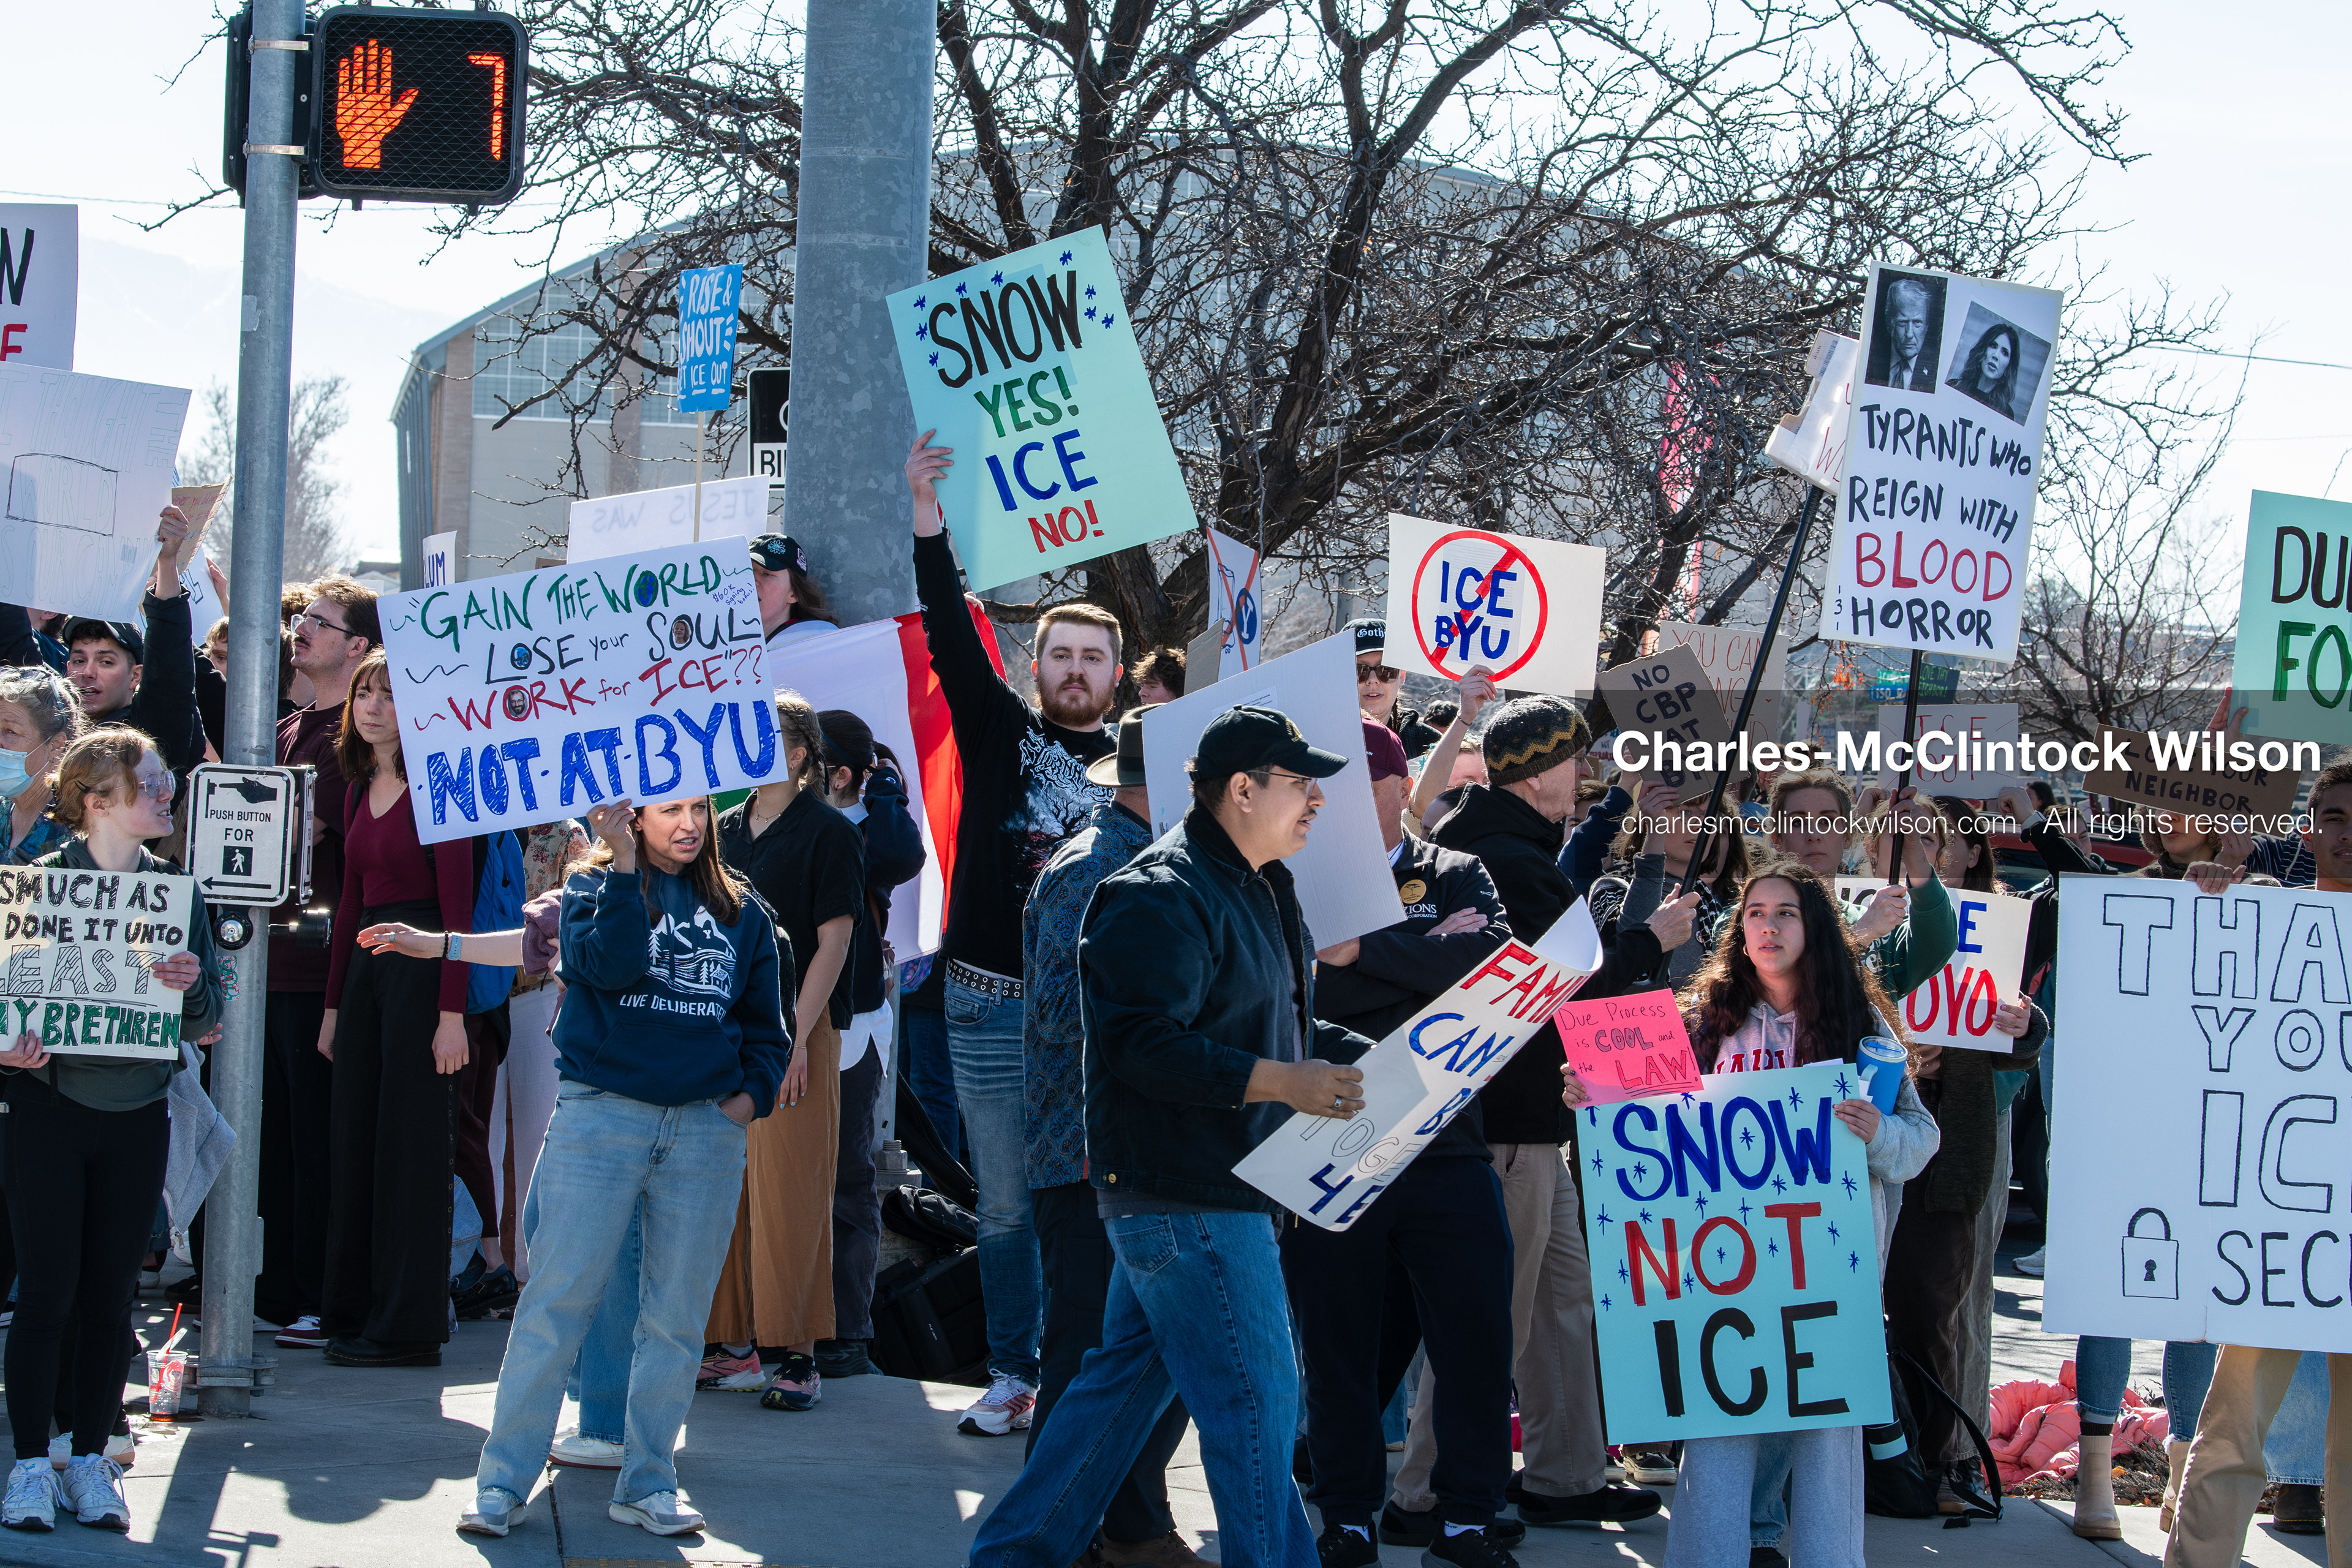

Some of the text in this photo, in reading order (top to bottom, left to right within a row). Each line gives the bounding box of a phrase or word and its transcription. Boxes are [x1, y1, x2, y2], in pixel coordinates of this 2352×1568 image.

[468, 51, 505, 160] 7
[687, 271, 733, 318] RISE &
[680, 317, 725, 365] SHOUT
[929, 270, 1082, 388] SNOW
[691, 363, 706, 388] ICE
[711, 361, 728, 386] OUT
[974, 366, 1079, 437] YES!
[29, 373, 162, 473] THOUGHT
[1860, 404, 2031, 476] TYRANTS WHO
[20, 454, 116, 536] WORLD
[986, 429, 1098, 512] ICE
[1028, 499, 1104, 554] NO!
[1849, 475, 2018, 544] REIGN WITH
[25, 527, 67, 605] OUR
[547, 573, 598, 622] THE
[593, 555, 723, 614] WORLD
[737, 582, 755, 604] bonus!
[1441, 560, 1517, 618] ICE
[1856, 530, 2012, 601] BLOOD
[2271, 526, 2352, 612] DU
[725, 588, 746, 605] signing
[1852, 597, 1994, 649] HORROR
[485, 607, 760, 685] LOSE your SOUL
[1435, 611, 1510, 661] BYU
[1631, 665, 1670, 692] NO
[2272, 620, 2352, 712] FO
[447, 676, 597, 731] WORK
[599, 679, 631, 703] for
[1636, 682, 1697, 724] CBP
[1666, 717, 1701, 748] AT
[209, 810, 271, 823] PUSH BUTTON
[2125, 770, 2253, 815] NEIGHBOR
[224, 827, 254, 842] FOR
[126, 880, 171, 913] AS
[4, 912, 183, 946] DONE IT UNTO
[703, 929, 711, 939] Y
[42, 1001, 181, 1049] BRETHREN
[619, 994, 648, 1008] LIVE
[1558, 1002, 1666, 1030] Due Process
[1408, 1012, 1515, 1077] CAN
[1576, 1027, 1675, 1053] is COOL and
[1578, 1046, 1699, 1091] the LAW!
[1612, 1096, 1833, 1202] SNOW
[2199, 1089, 2352, 1215] IC
[1624, 1202, 1822, 1306] NOT
[2211, 1230, 2352, 1308] SEC
[1653, 1300, 1850, 1419] ICE
